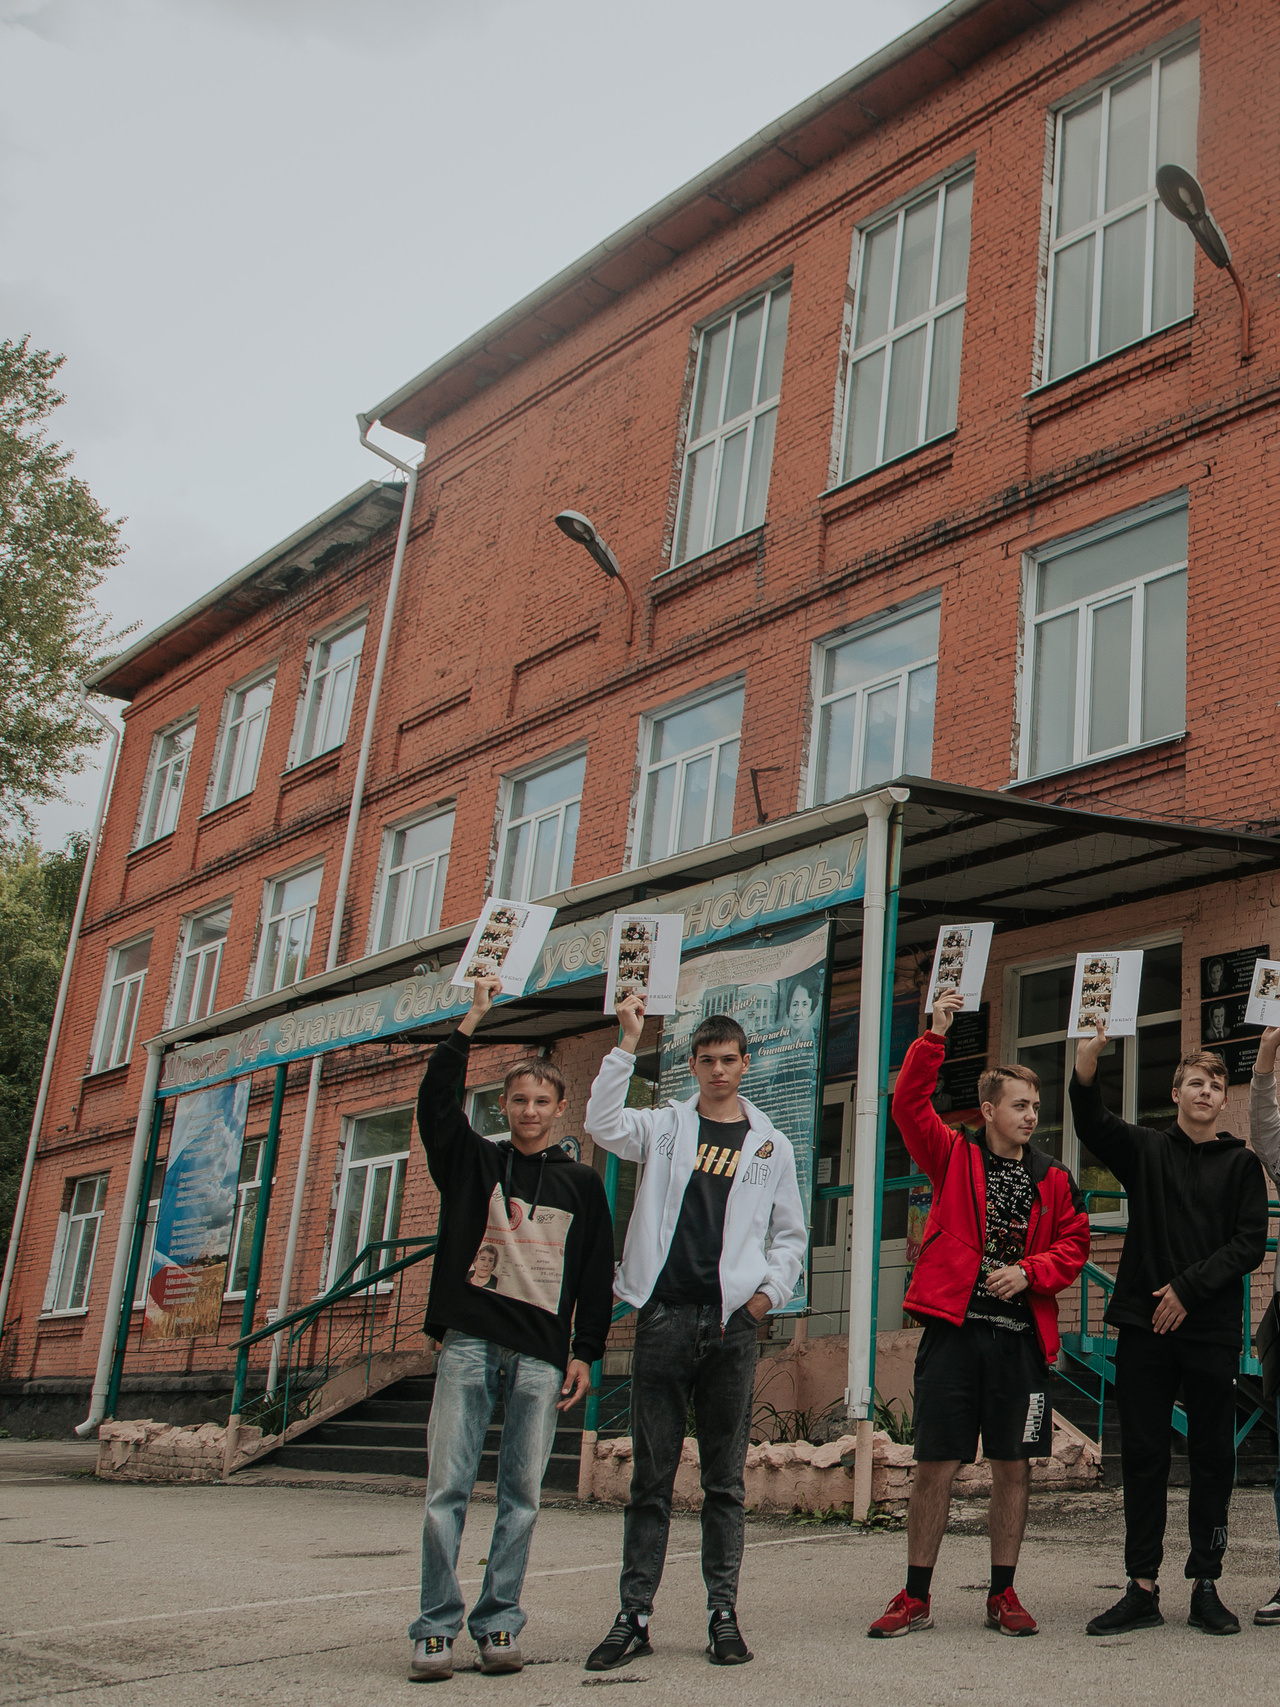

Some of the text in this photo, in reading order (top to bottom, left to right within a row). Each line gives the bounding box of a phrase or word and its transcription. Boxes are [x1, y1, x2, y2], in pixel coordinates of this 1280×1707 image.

[160, 1047, 231, 1086] Школа
[236, 1028, 270, 1068] 14-
[275, 1000, 385, 1055] Знания,
[536, 837, 863, 990] увеность!
[758, 1037, 813, 1058] Степановна
